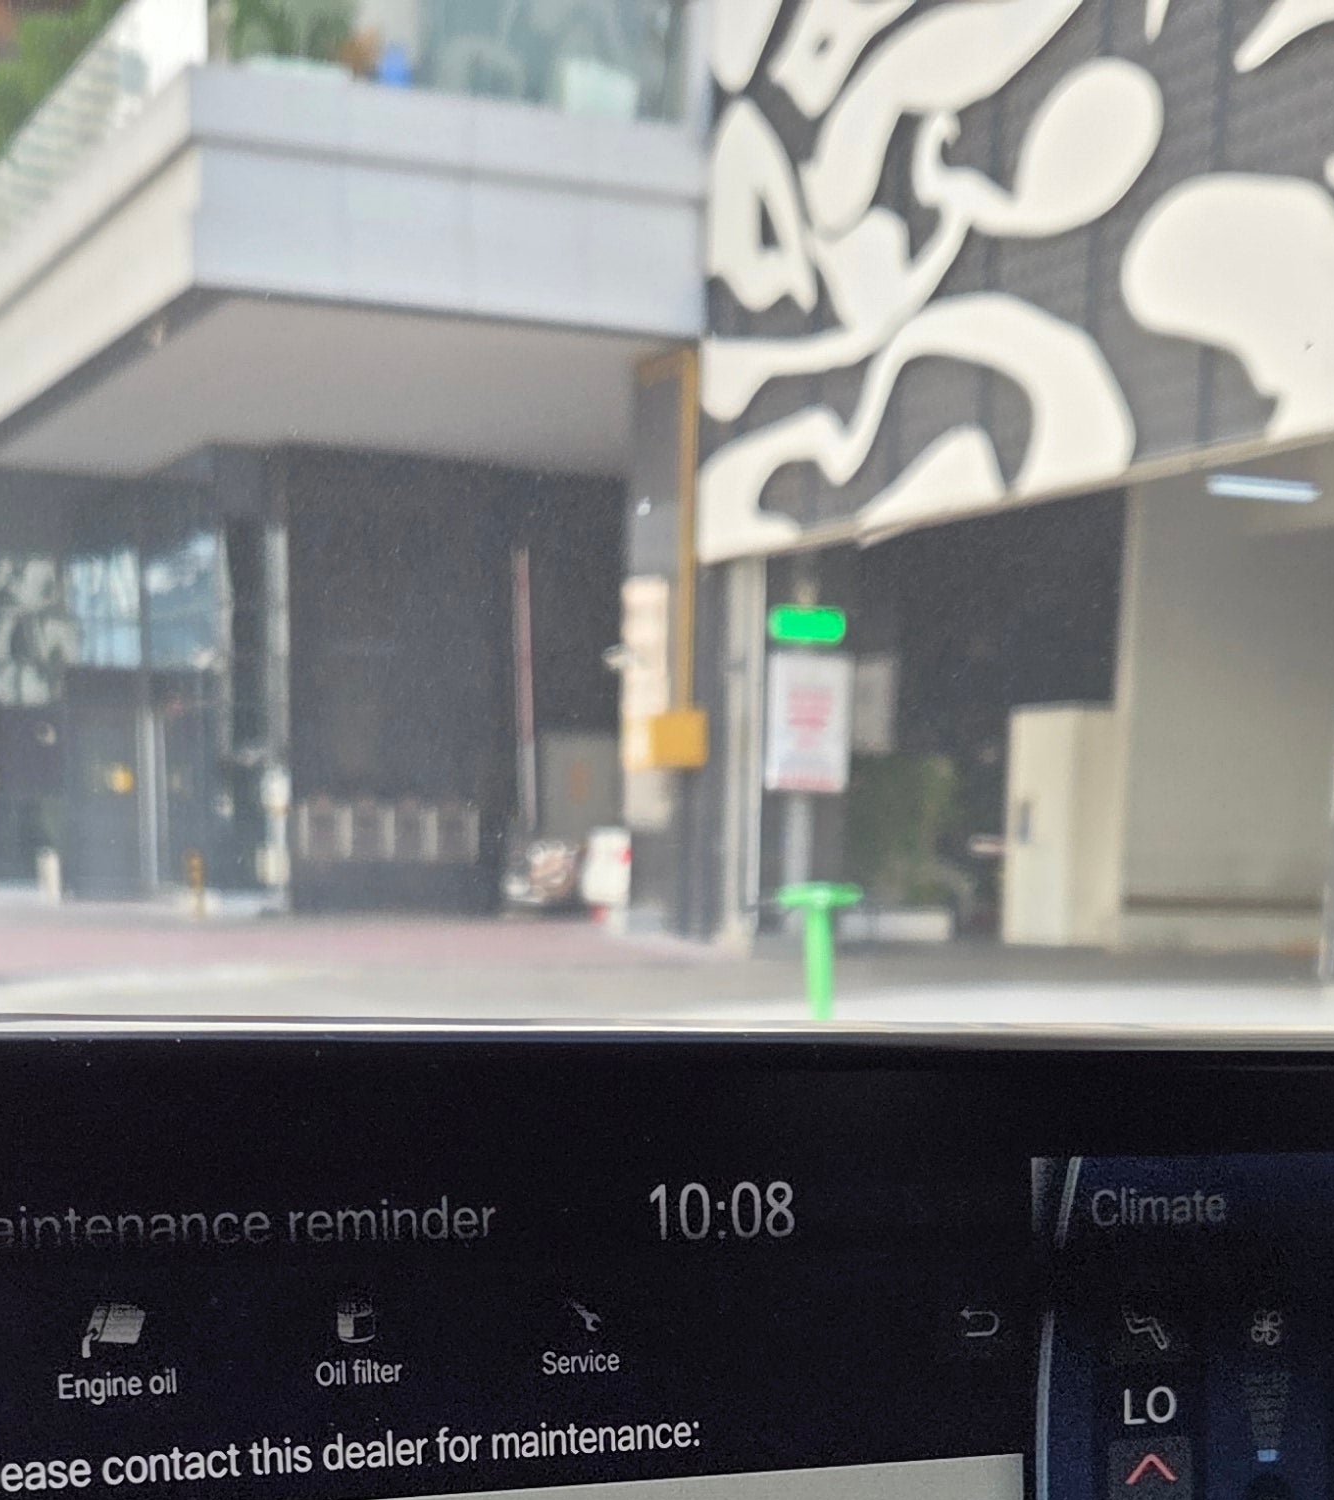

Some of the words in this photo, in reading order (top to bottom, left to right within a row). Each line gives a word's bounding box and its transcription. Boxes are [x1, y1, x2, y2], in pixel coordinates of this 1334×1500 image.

[287, 1195, 497, 1243] reminder
[647, 1182, 797, 1240] 10:08
[1091, 1188, 1227, 1228] Climate
[314, 1360, 348, 1387] Oil
[355, 1358, 403, 1385] filter
[542, 1349, 620, 1375] Service
[56, 1373, 141, 1404] Engine
[149, 1369, 178, 1396] oil
[1123, 1386, 1178, 1425] LO
[101, 1445, 241, 1488] contact
[249, 1437, 314, 1477] this
[321, 1429, 431, 1473] dealer
[435, 1425, 483, 1464] for
[491, 1421, 700, 1461] maintenance:
